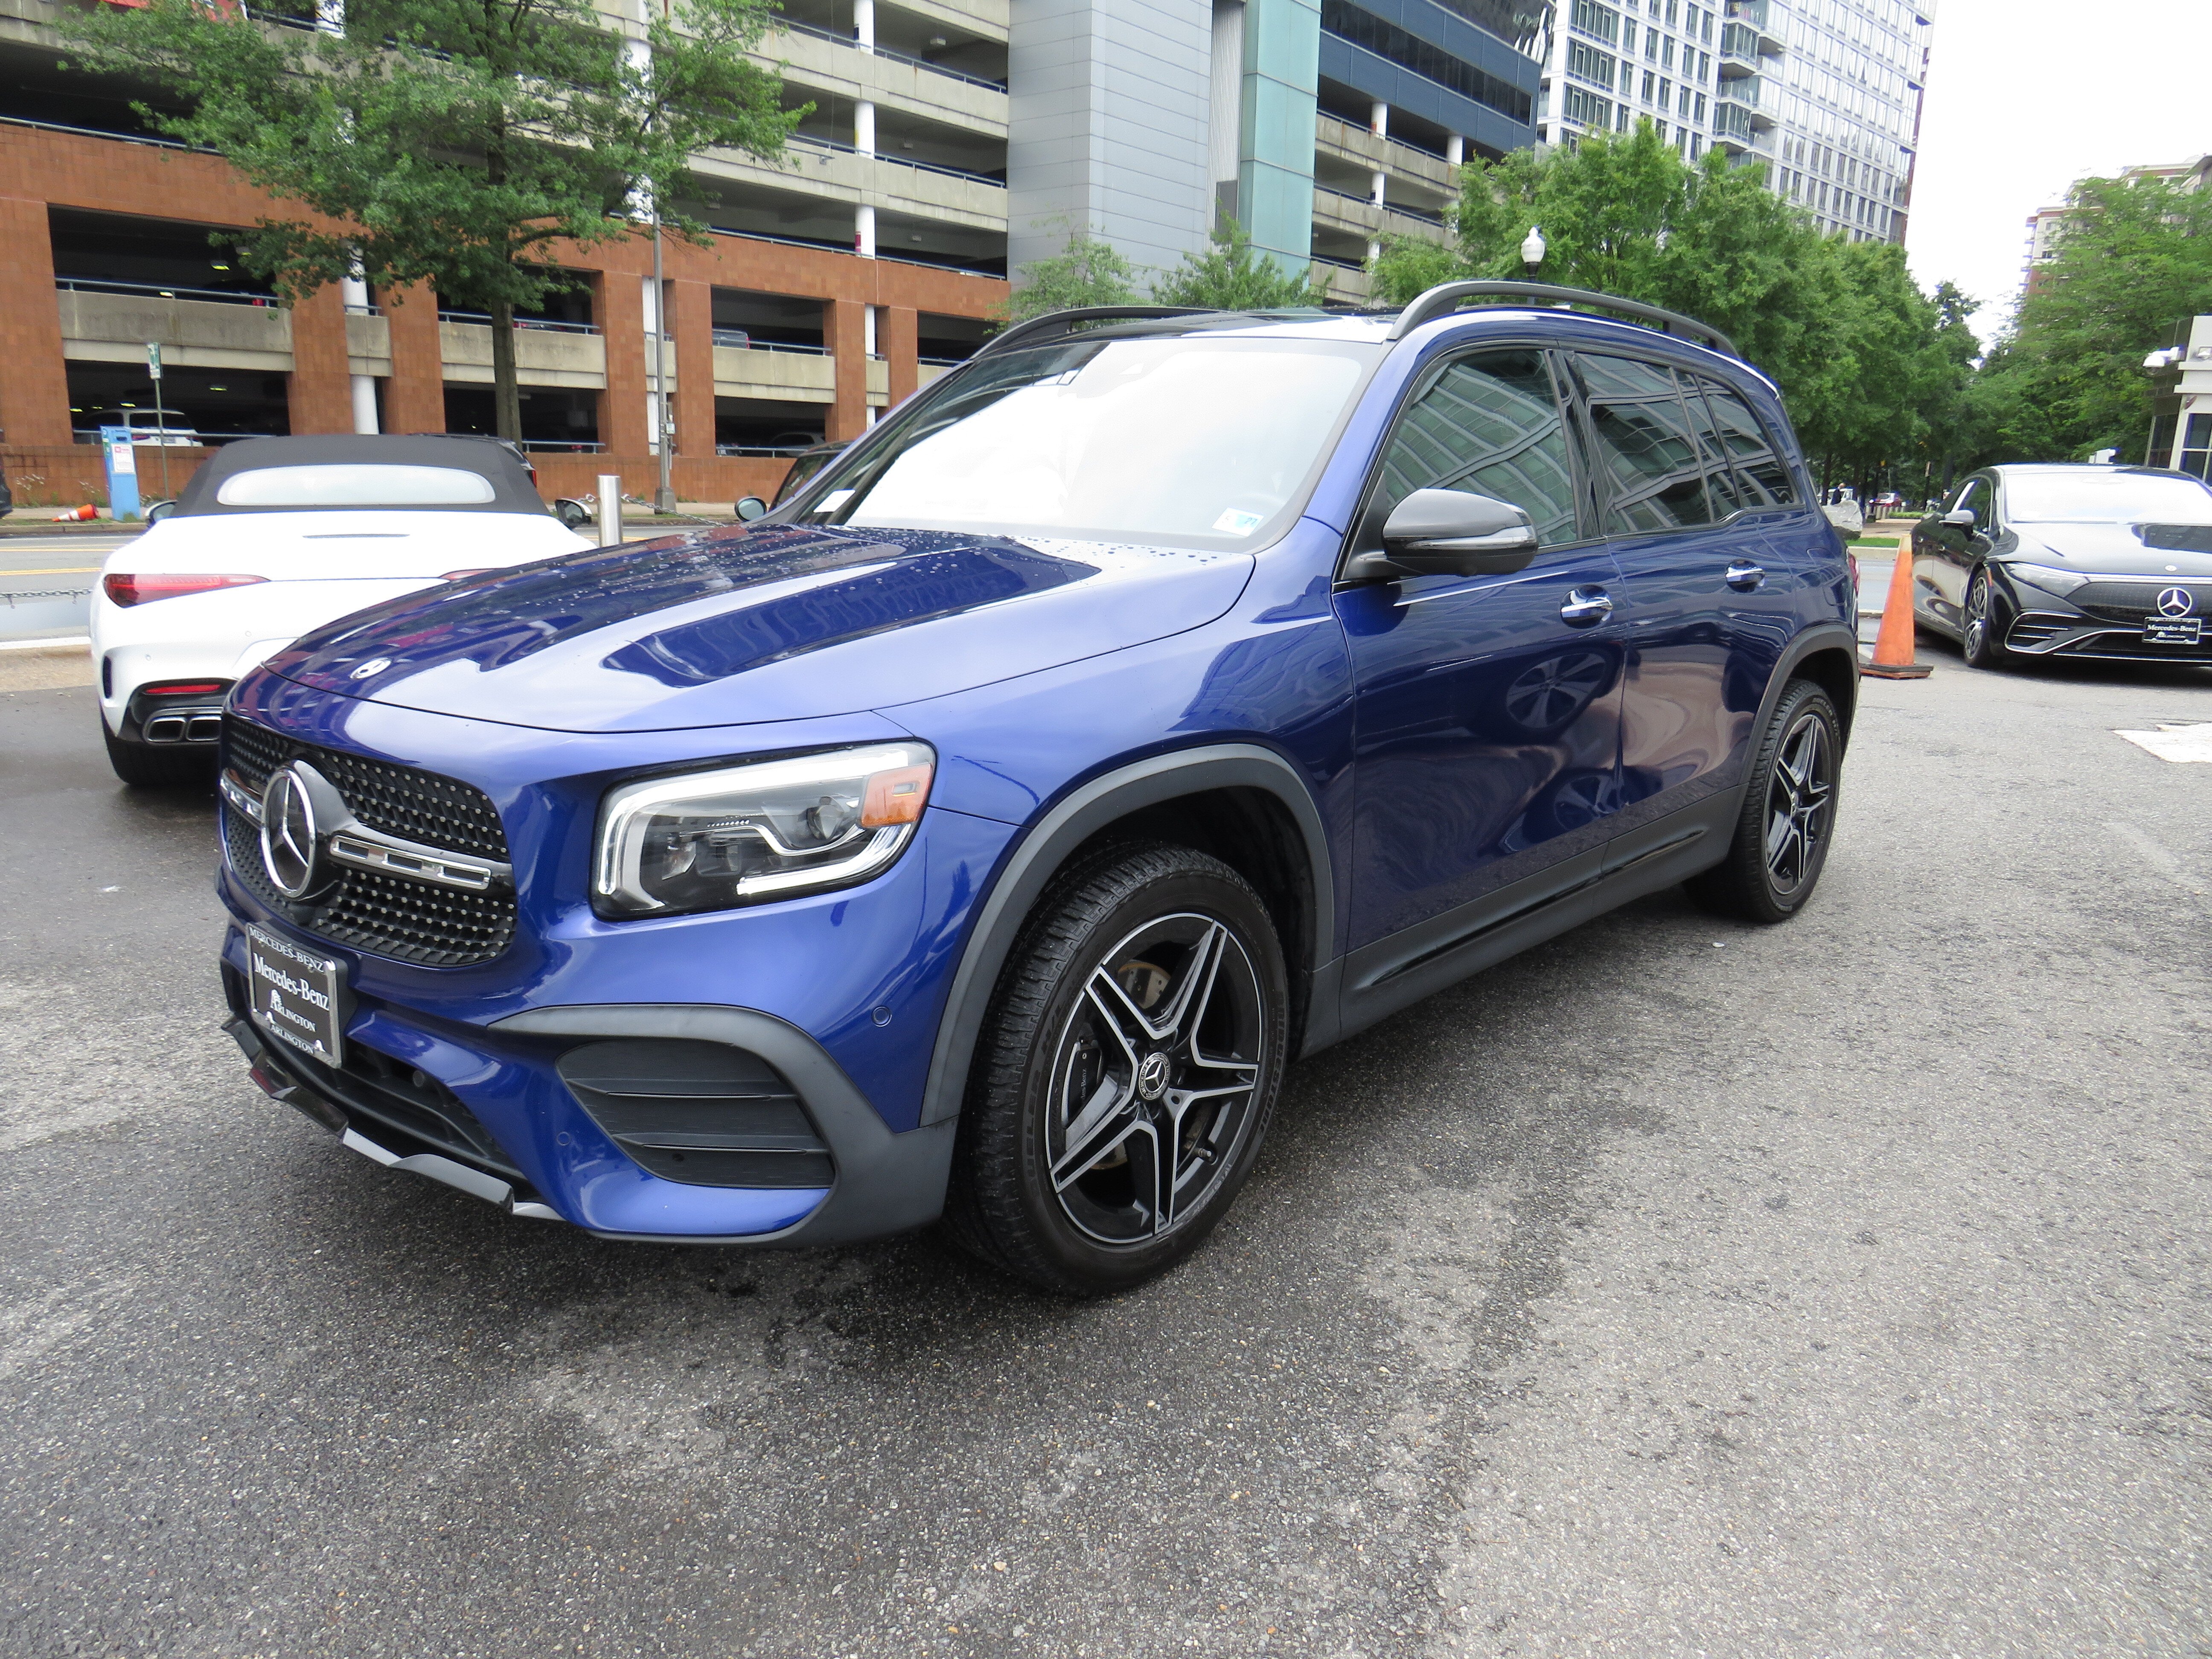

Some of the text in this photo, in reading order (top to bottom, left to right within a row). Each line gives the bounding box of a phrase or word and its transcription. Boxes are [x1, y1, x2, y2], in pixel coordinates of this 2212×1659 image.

[249, 926, 324, 972] MERCEDES-BENZ
[253, 952, 329, 1011] Mercedes-Benz
[270, 999, 316, 1033] ARLINGTON
[271, 1025, 314, 1054] ARLINGTON
[1258, 991, 1285, 1138] BRIDGESTONE
